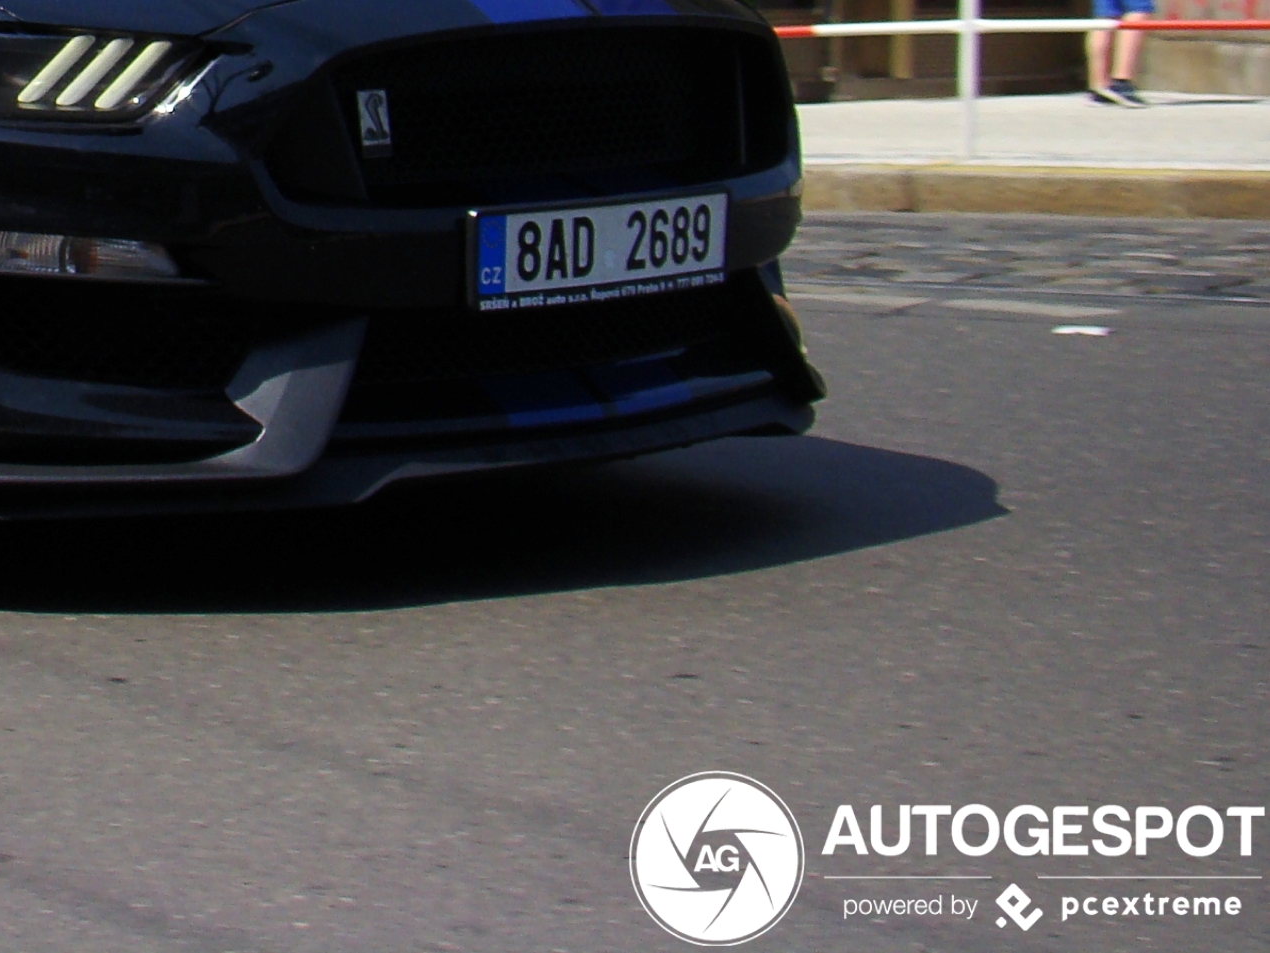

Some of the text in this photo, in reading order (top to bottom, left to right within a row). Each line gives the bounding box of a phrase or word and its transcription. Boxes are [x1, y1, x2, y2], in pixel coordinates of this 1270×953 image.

[517, 203, 712, 282] 8AD 2689
[481, 267, 502, 284] CZ
